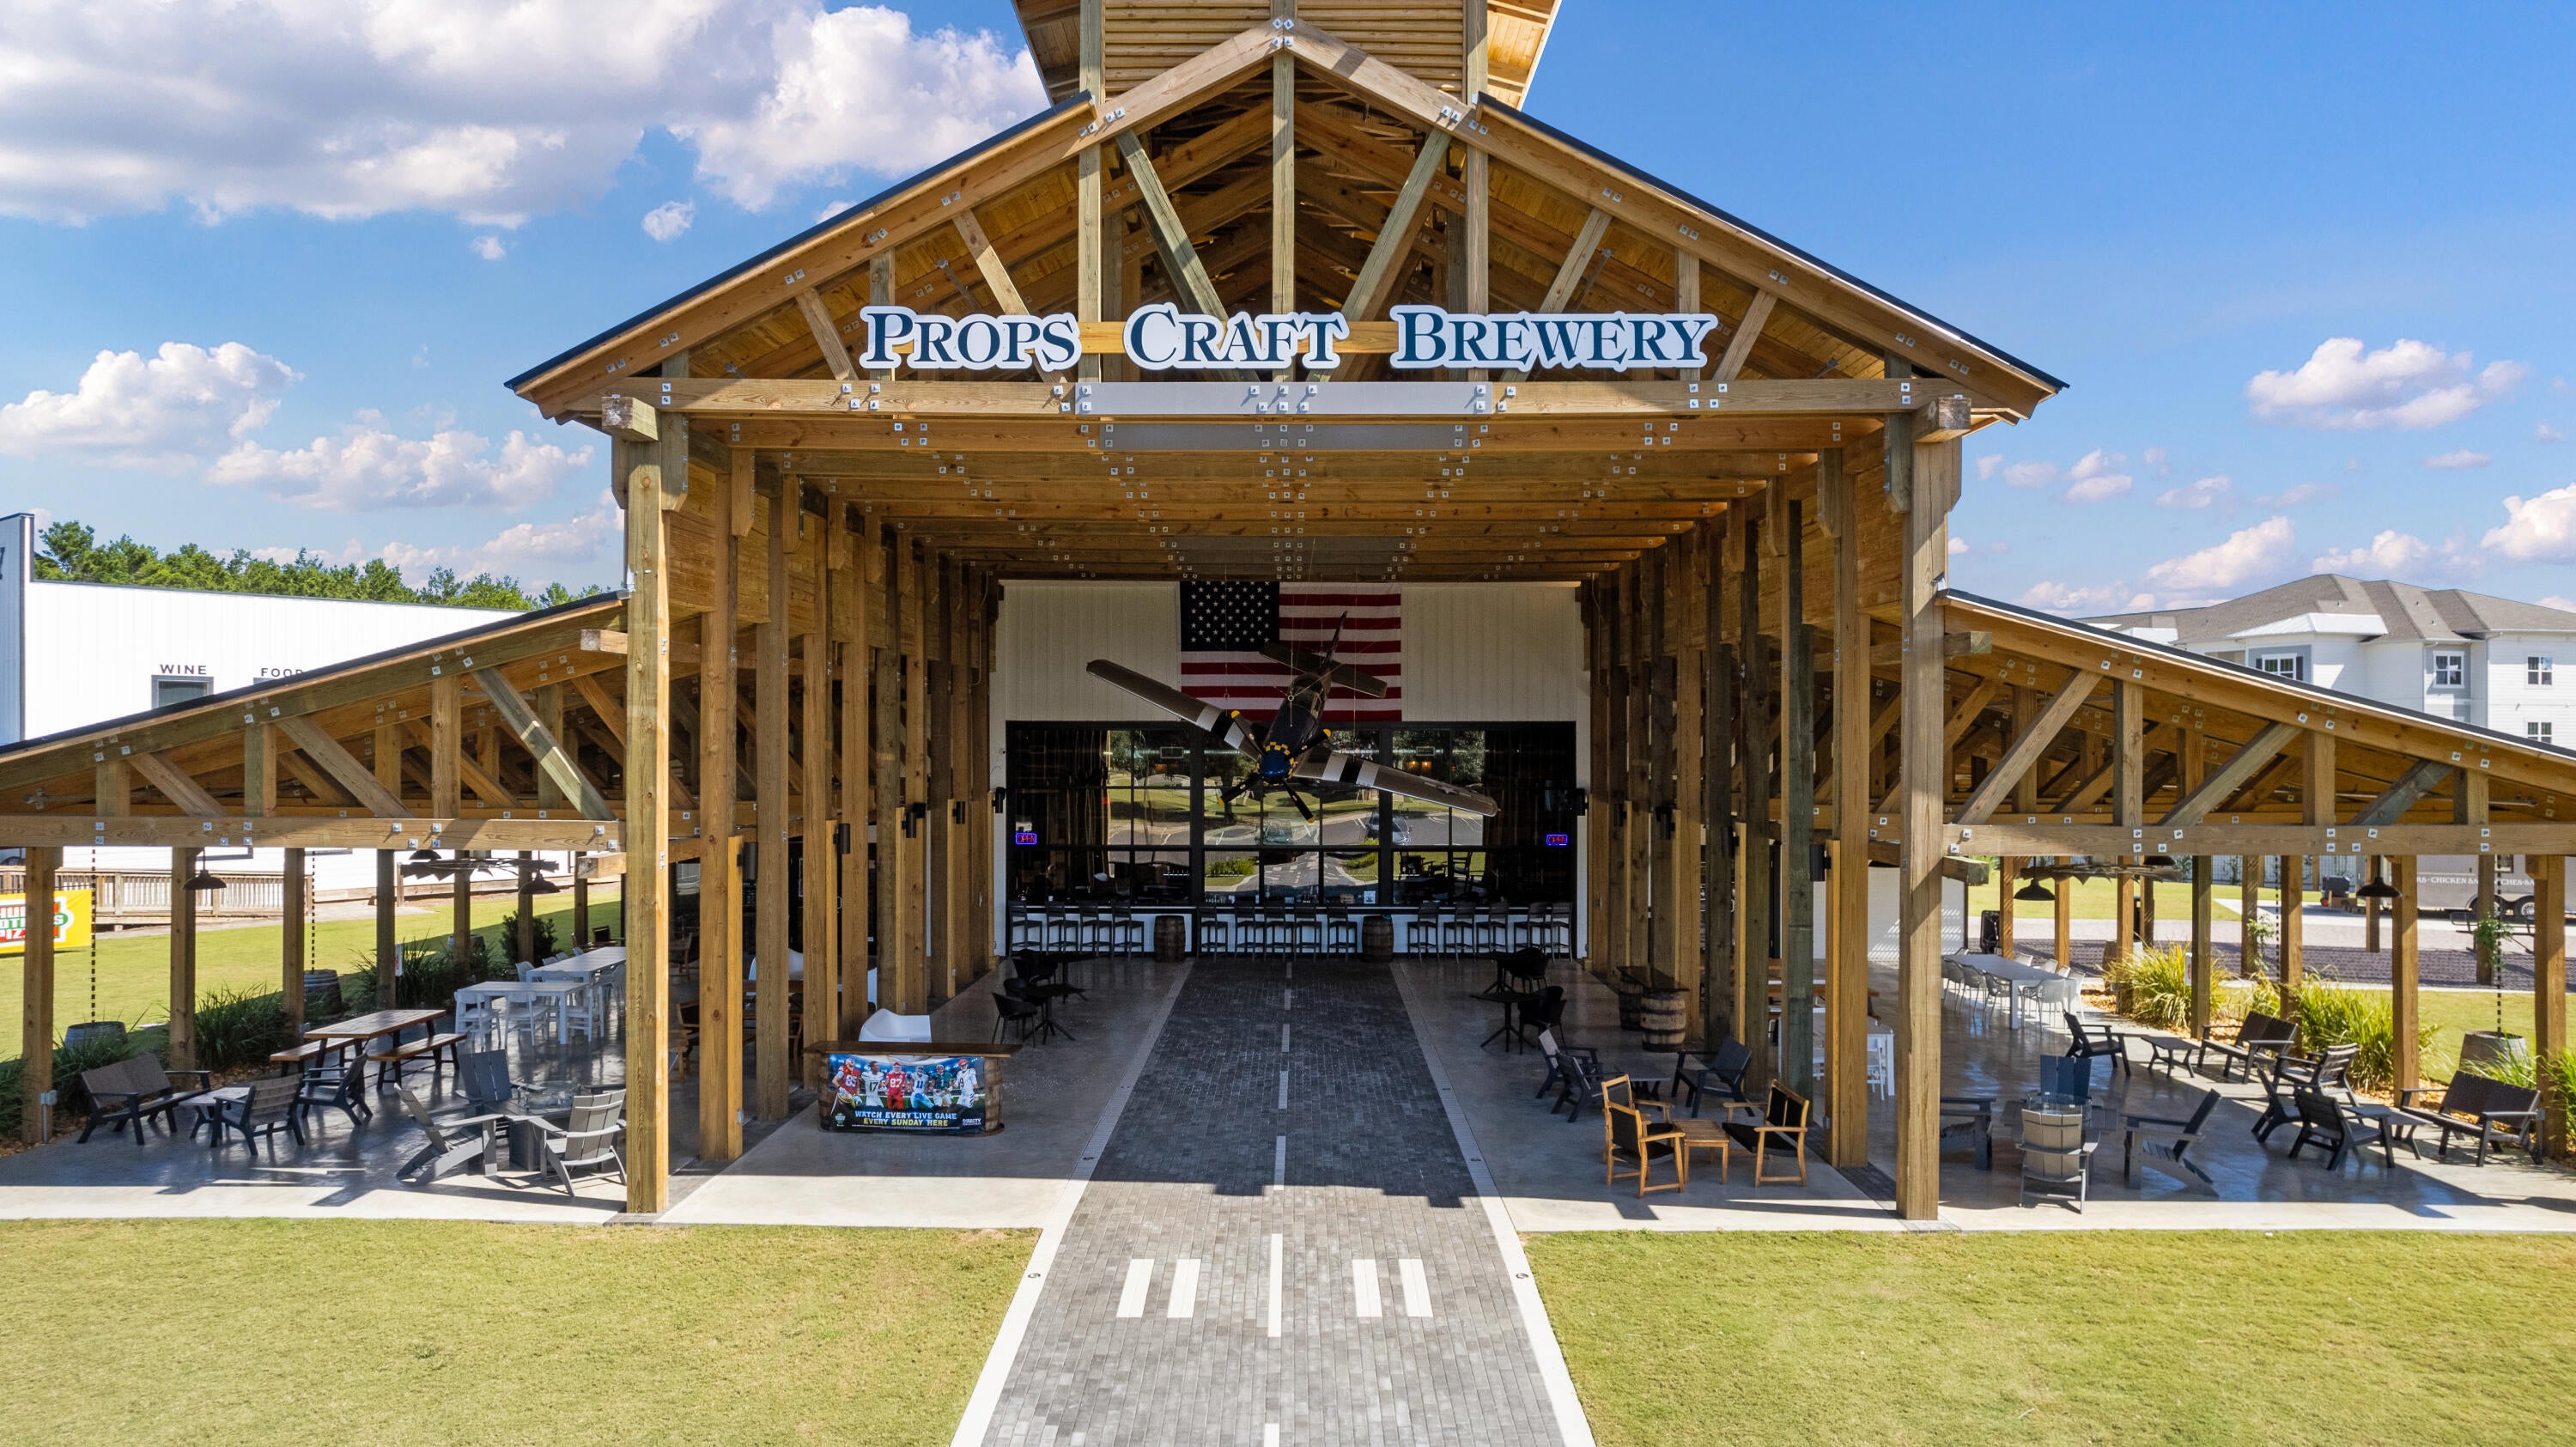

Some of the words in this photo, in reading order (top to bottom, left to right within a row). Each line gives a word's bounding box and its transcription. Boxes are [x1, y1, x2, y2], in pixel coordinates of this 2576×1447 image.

[866, 312, 1075, 365] PROPS
[1129, 309, 1344, 363] CRAFT
[1396, 312, 1711, 365] BREWERY
[160, 664, 207, 675] WINE
[2430, 876, 2467, 885] CHICKEN
[845, 1075, 857, 1087] 85
[869, 1081, 879, 1091] 17
